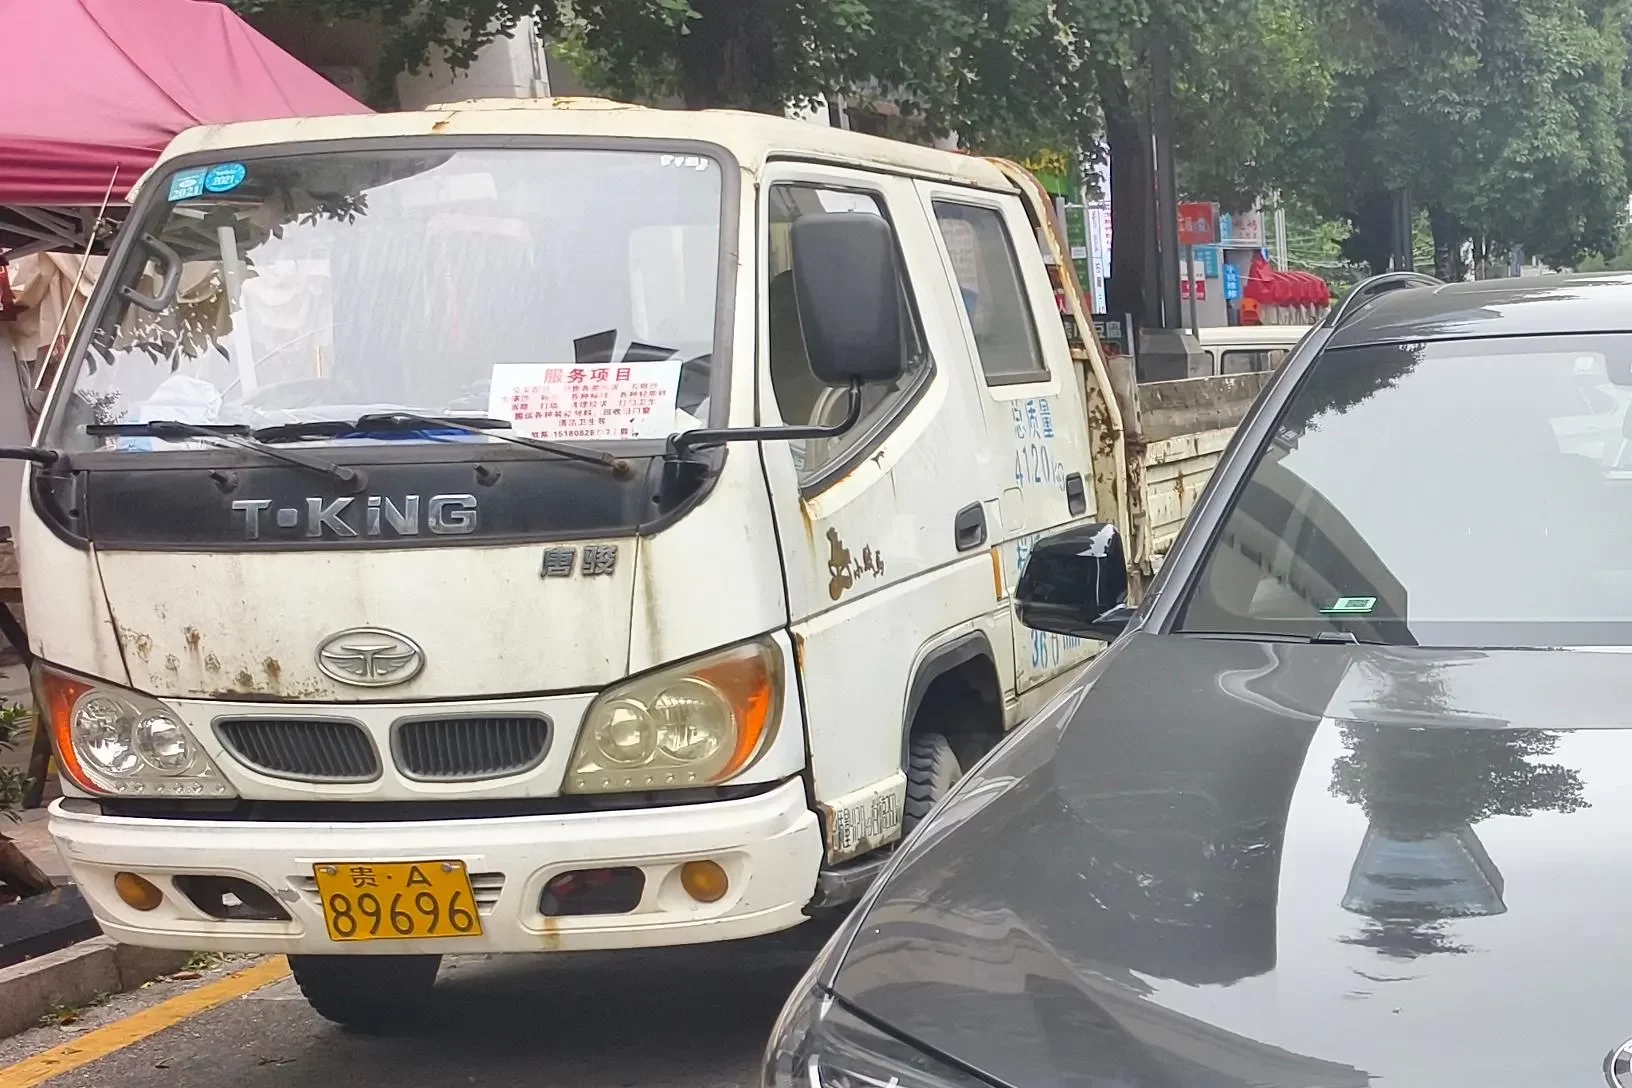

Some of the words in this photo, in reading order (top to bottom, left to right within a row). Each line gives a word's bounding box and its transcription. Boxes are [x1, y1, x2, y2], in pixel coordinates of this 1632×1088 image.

[543, 367, 631, 384] 服务项目
[540, 544, 618, 579] 唐骏
[328, 890, 474, 937] 89696
